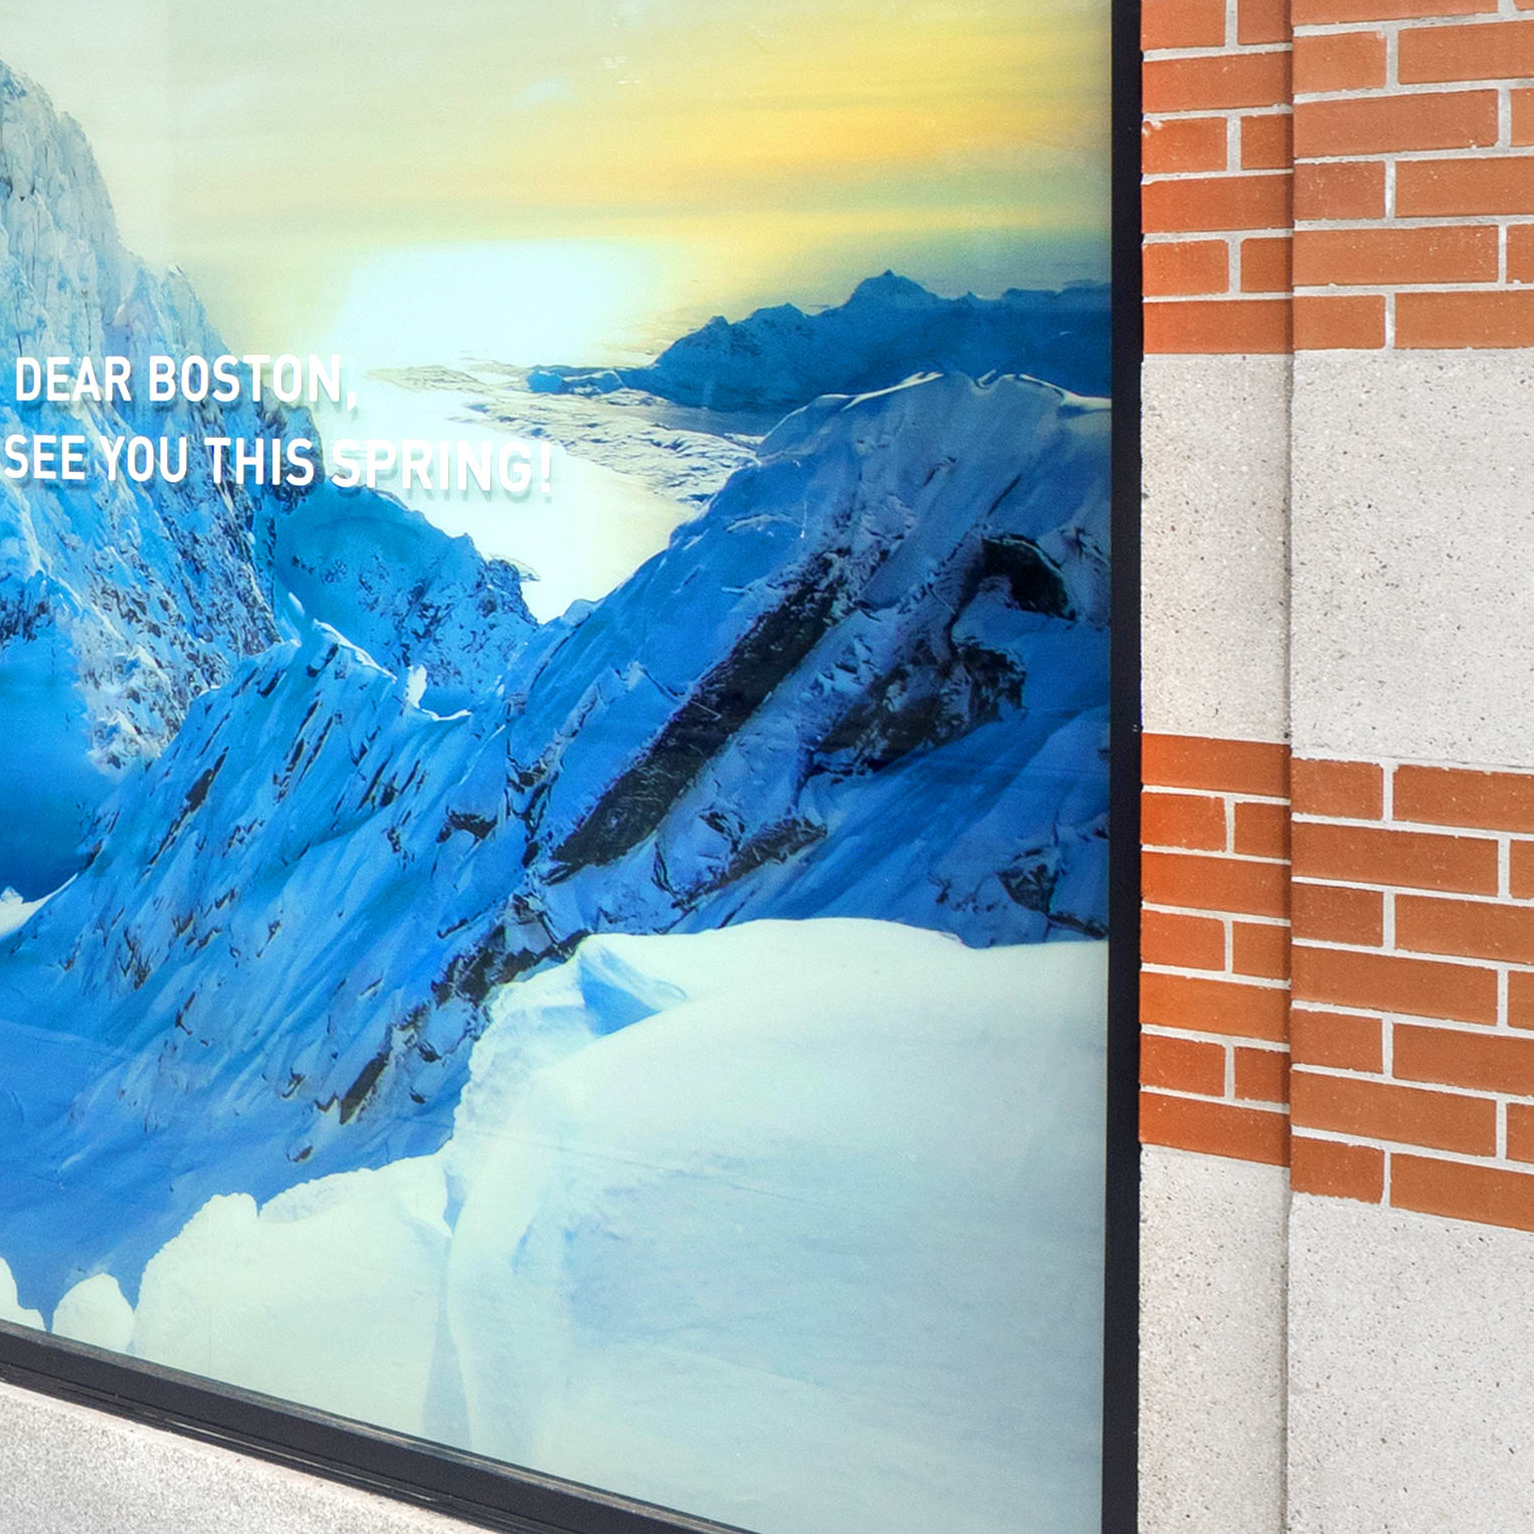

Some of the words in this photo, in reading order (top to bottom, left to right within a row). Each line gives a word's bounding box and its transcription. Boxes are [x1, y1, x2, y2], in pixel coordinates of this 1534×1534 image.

[16, 356, 132, 402] DEAR
[149, 354, 358, 413] BOSTON,
[3, 434, 85, 480] SEE
[98, 435, 188, 483] YOU
[204, 436, 315, 487] THIS
[330, 438, 555, 494] SPRING!
